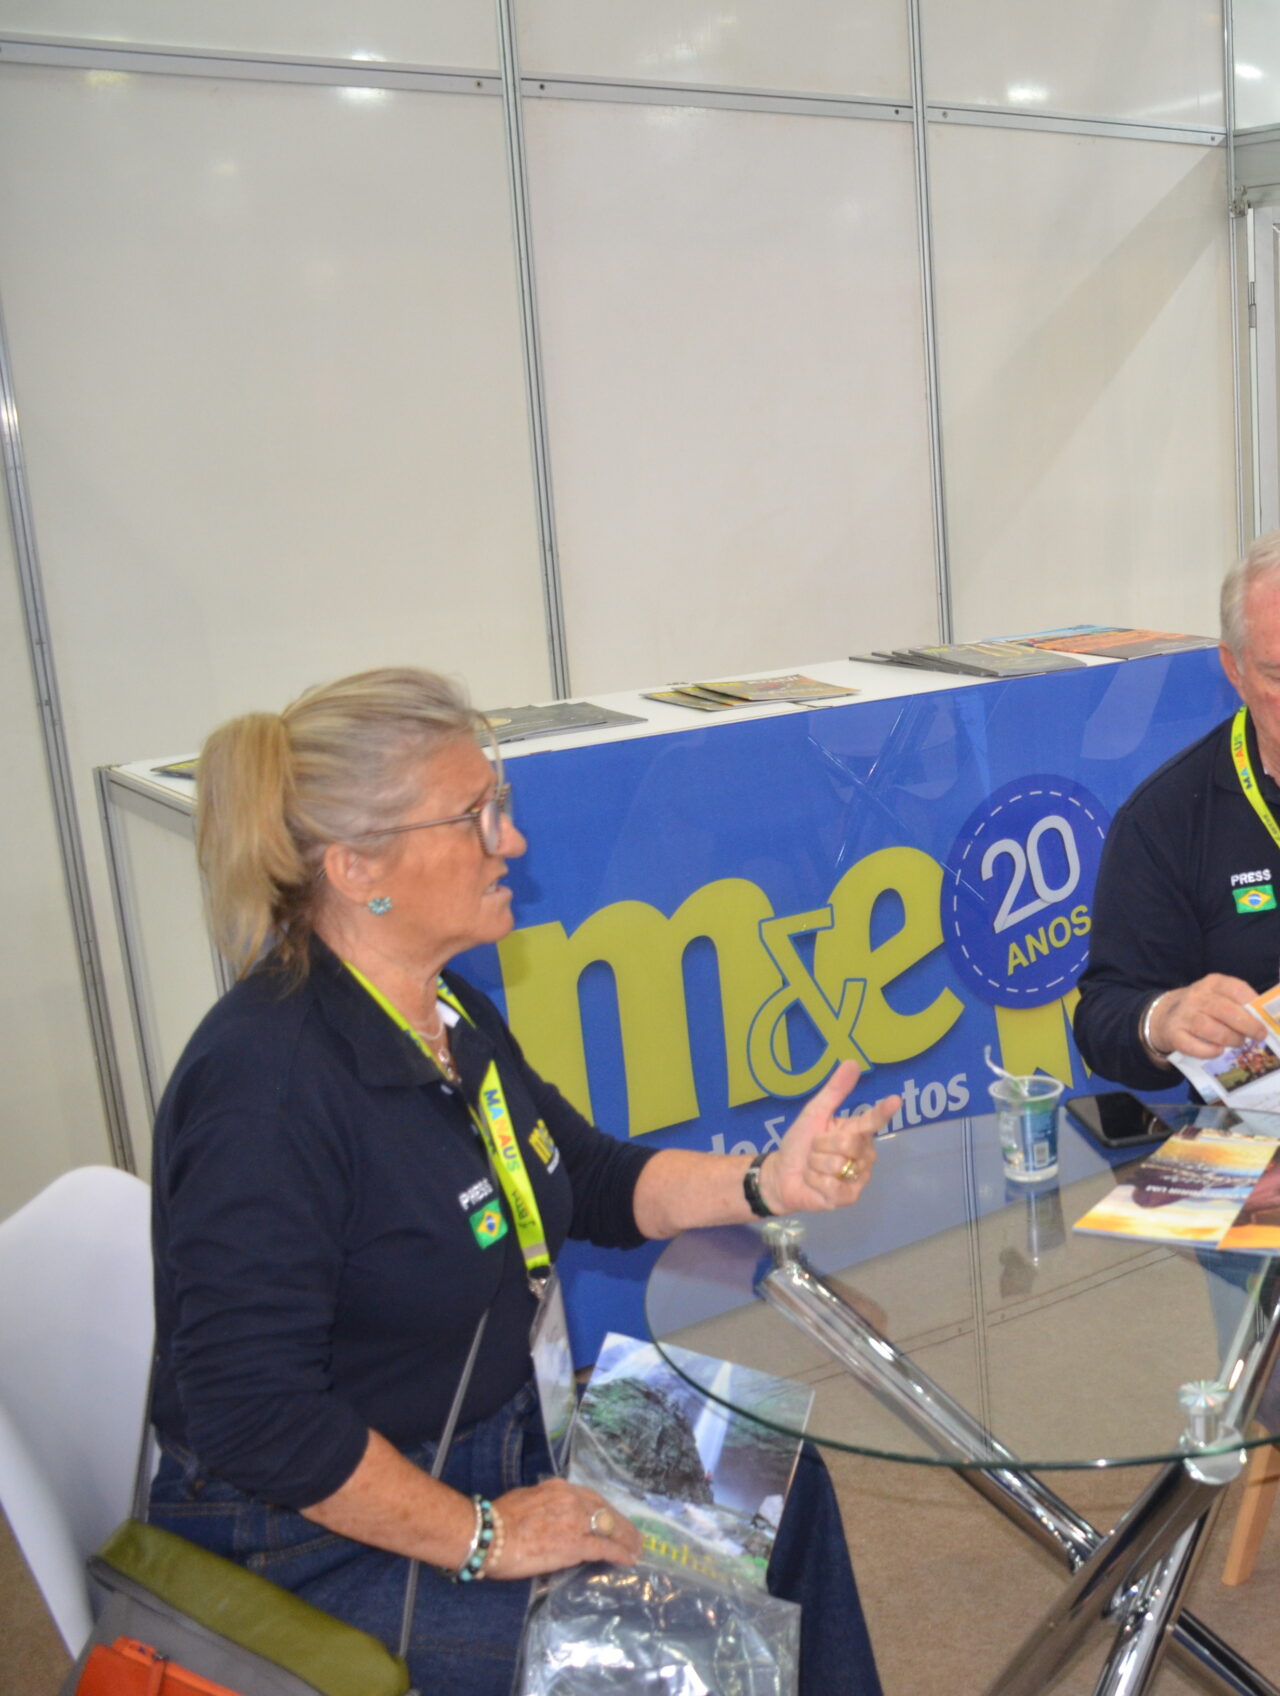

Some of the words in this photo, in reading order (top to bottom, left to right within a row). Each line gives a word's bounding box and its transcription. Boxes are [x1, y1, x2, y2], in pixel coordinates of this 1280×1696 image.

[1234, 733, 1252, 790] MANAUS
[981, 815, 1080, 934] 20
[1230, 868, 1273, 887] PRESS
[1008, 905, 1092, 976] ANOS
[496, 846, 965, 1136] m&e
[483, 1089, 521, 1172] MANAUS
